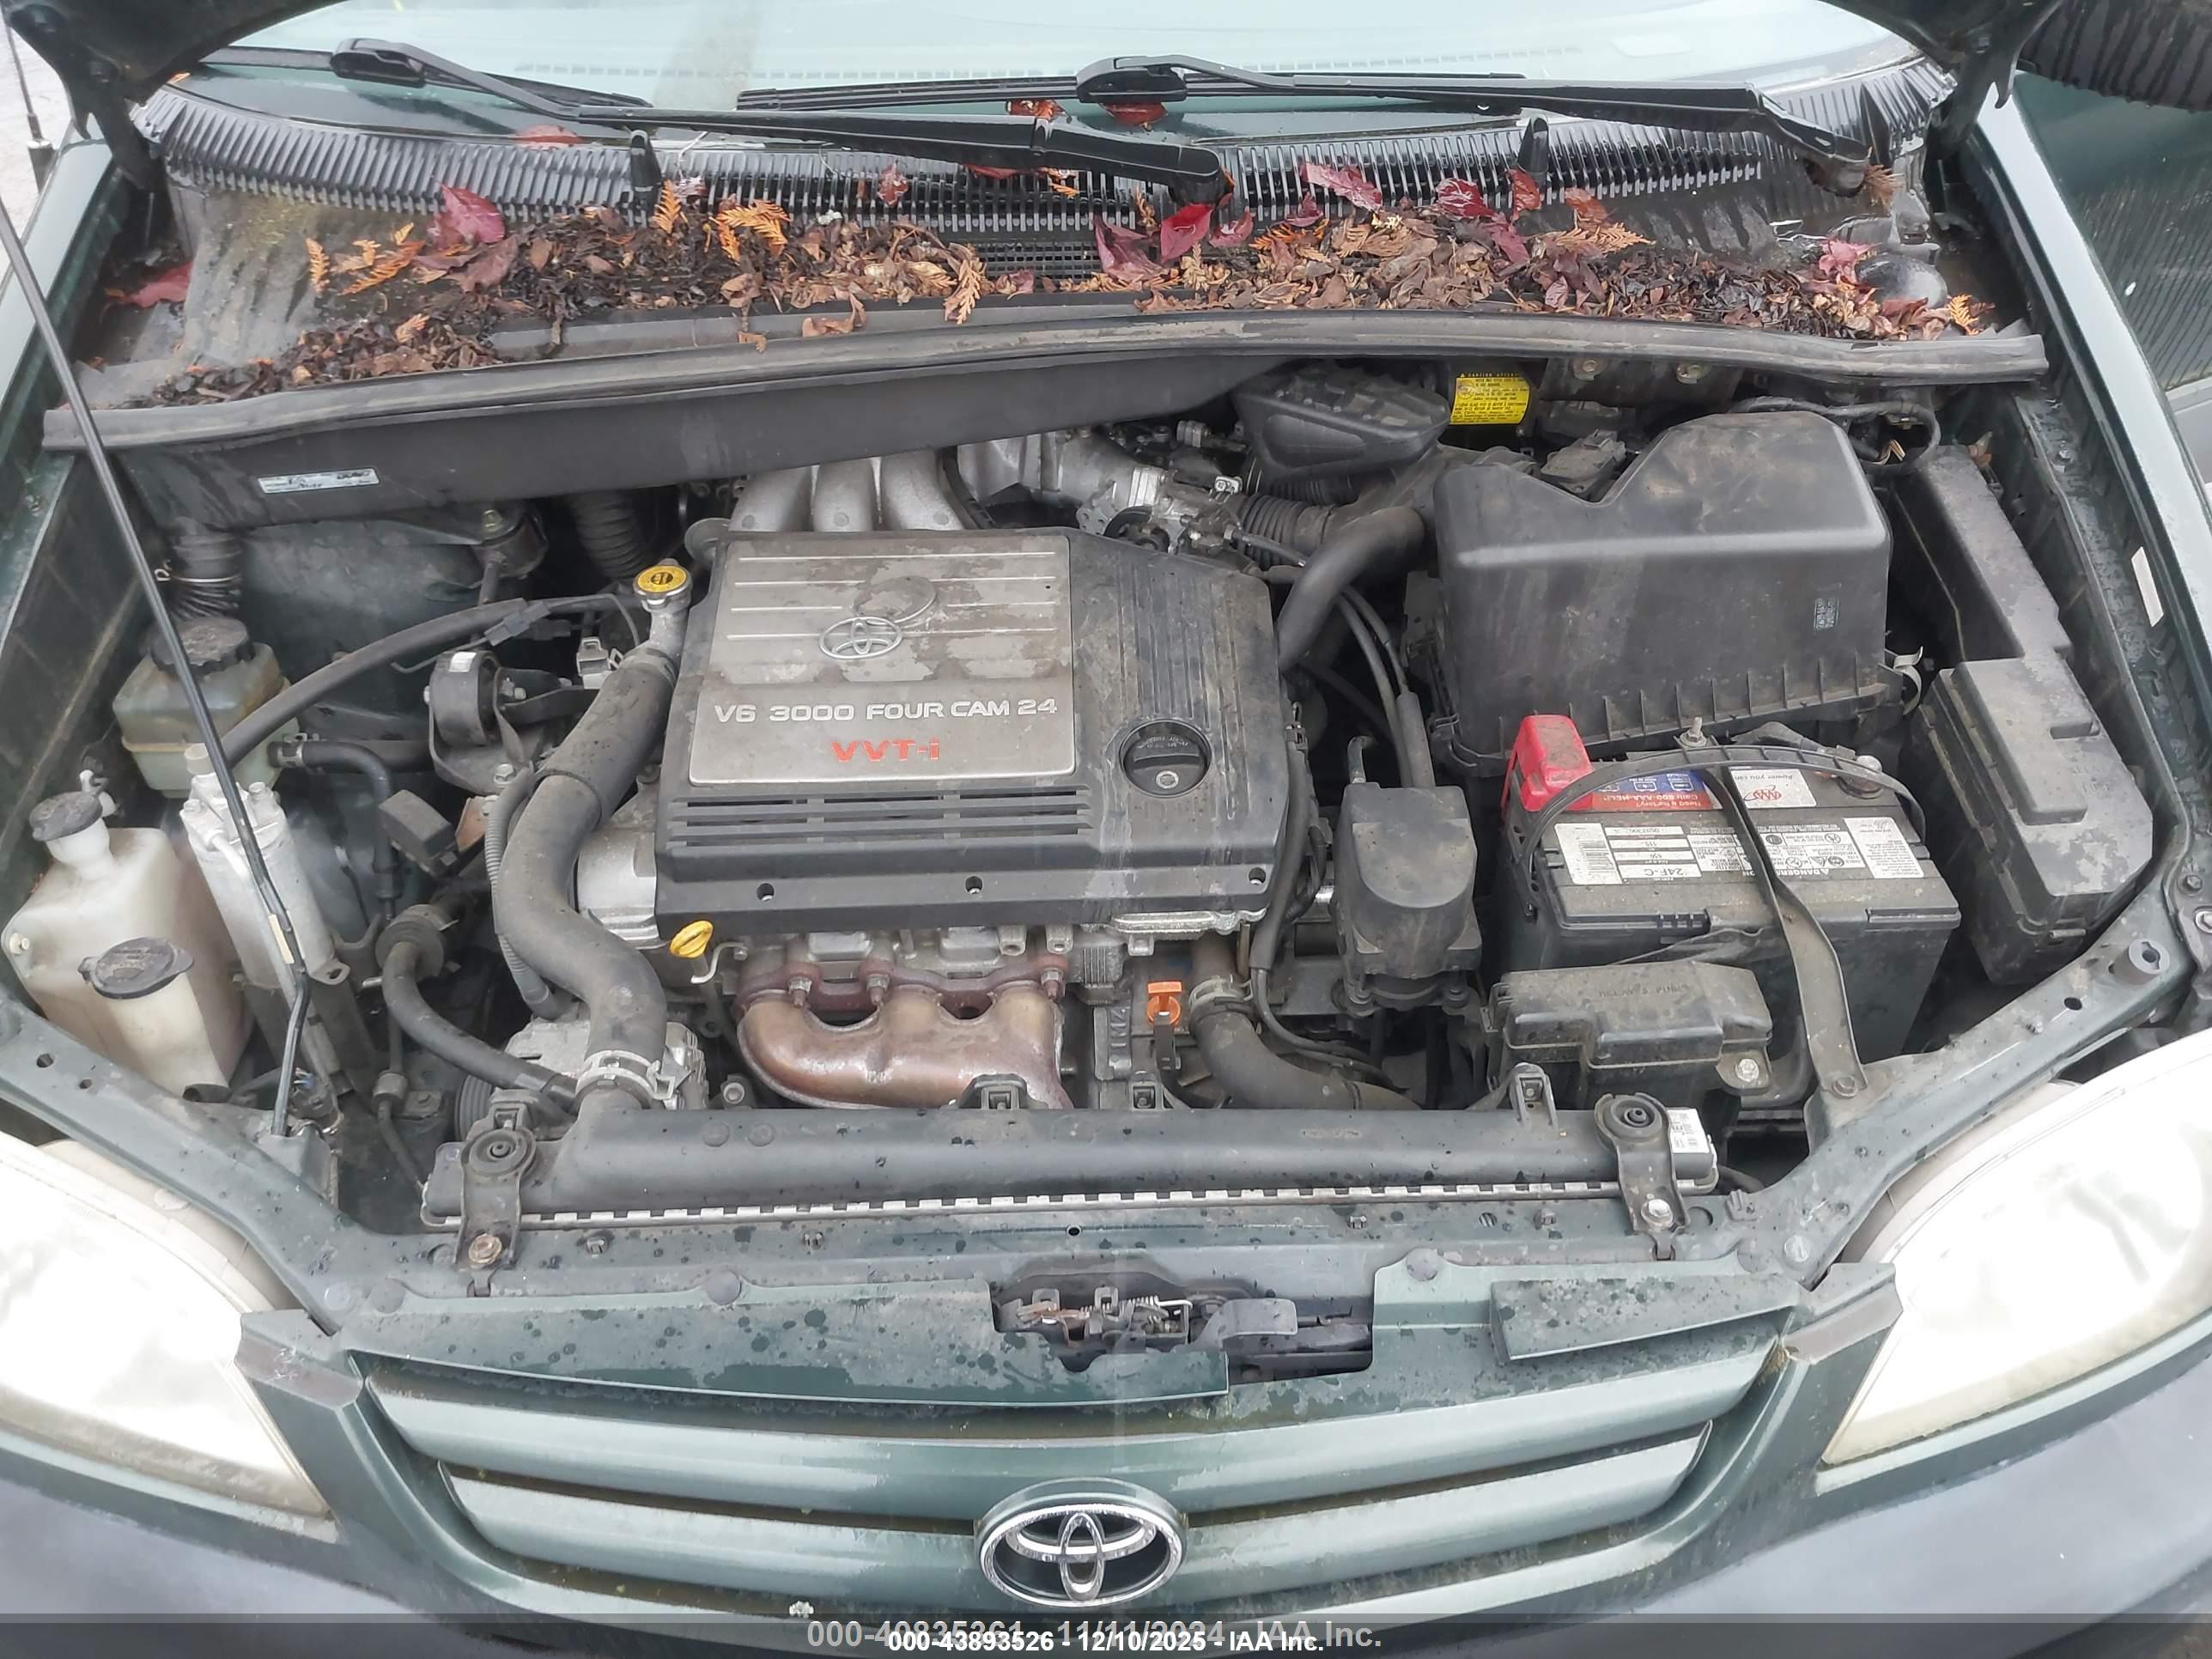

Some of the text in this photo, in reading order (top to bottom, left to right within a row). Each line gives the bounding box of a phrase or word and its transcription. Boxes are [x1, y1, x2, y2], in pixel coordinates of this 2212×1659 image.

[714, 698, 1058, 723] V6 3000 FOUR CAM 24
[830, 738, 941, 763] VVT-i
